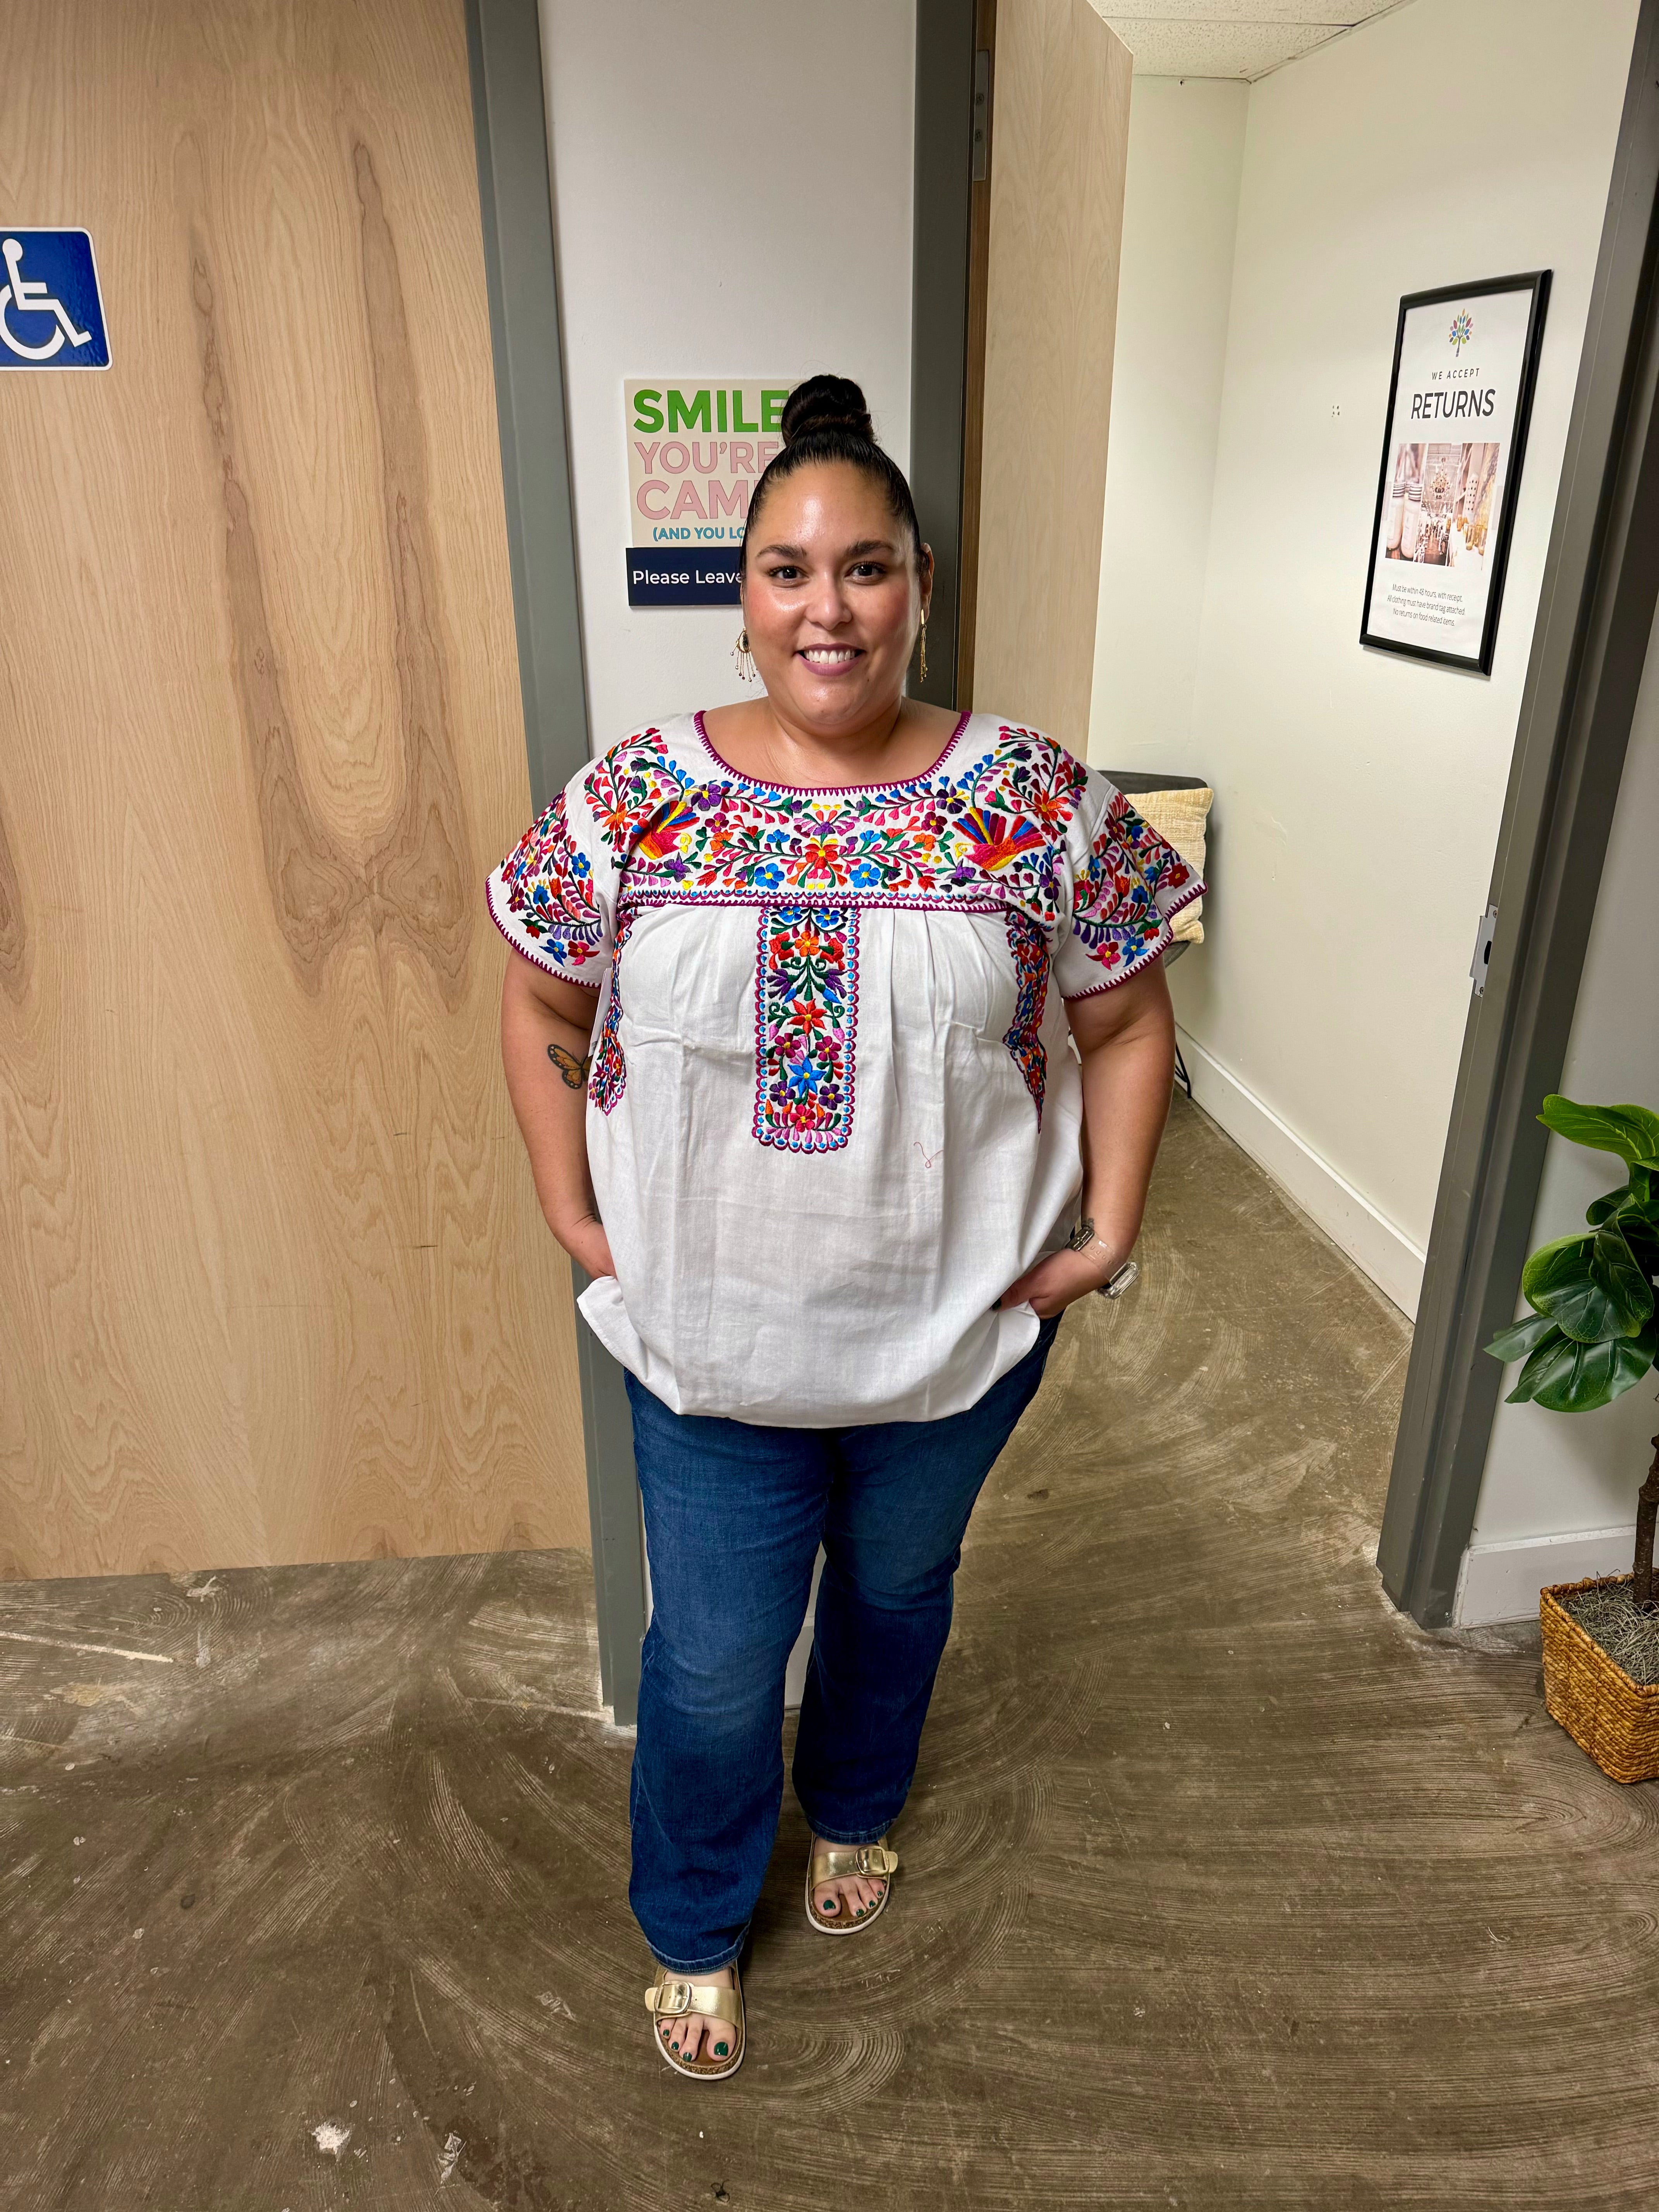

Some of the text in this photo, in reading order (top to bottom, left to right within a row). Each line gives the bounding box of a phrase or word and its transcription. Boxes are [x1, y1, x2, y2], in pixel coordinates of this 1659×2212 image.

[1432, 368, 1479, 380] WE ACCEPT
[634, 389, 789, 433] SMILE
[1411, 389, 1496, 419] RETURNS
[634, 441, 779, 474] YOU'RE
[637, 480, 760, 519] CAM
[653, 527, 690, 541] (AND
[694, 527, 725, 539] YOU
[633, 570, 742, 584] Please Leave
[1393, 607, 1399, 615] No
[1399, 610, 1412, 618] returns
[1419, 612, 1428, 621] food
[1429, 615, 1443, 624] related
[1417, 599, 1426, 608] have
[1427, 601, 1439, 611] brand
[1446, 606, 1465, 615] attached.
